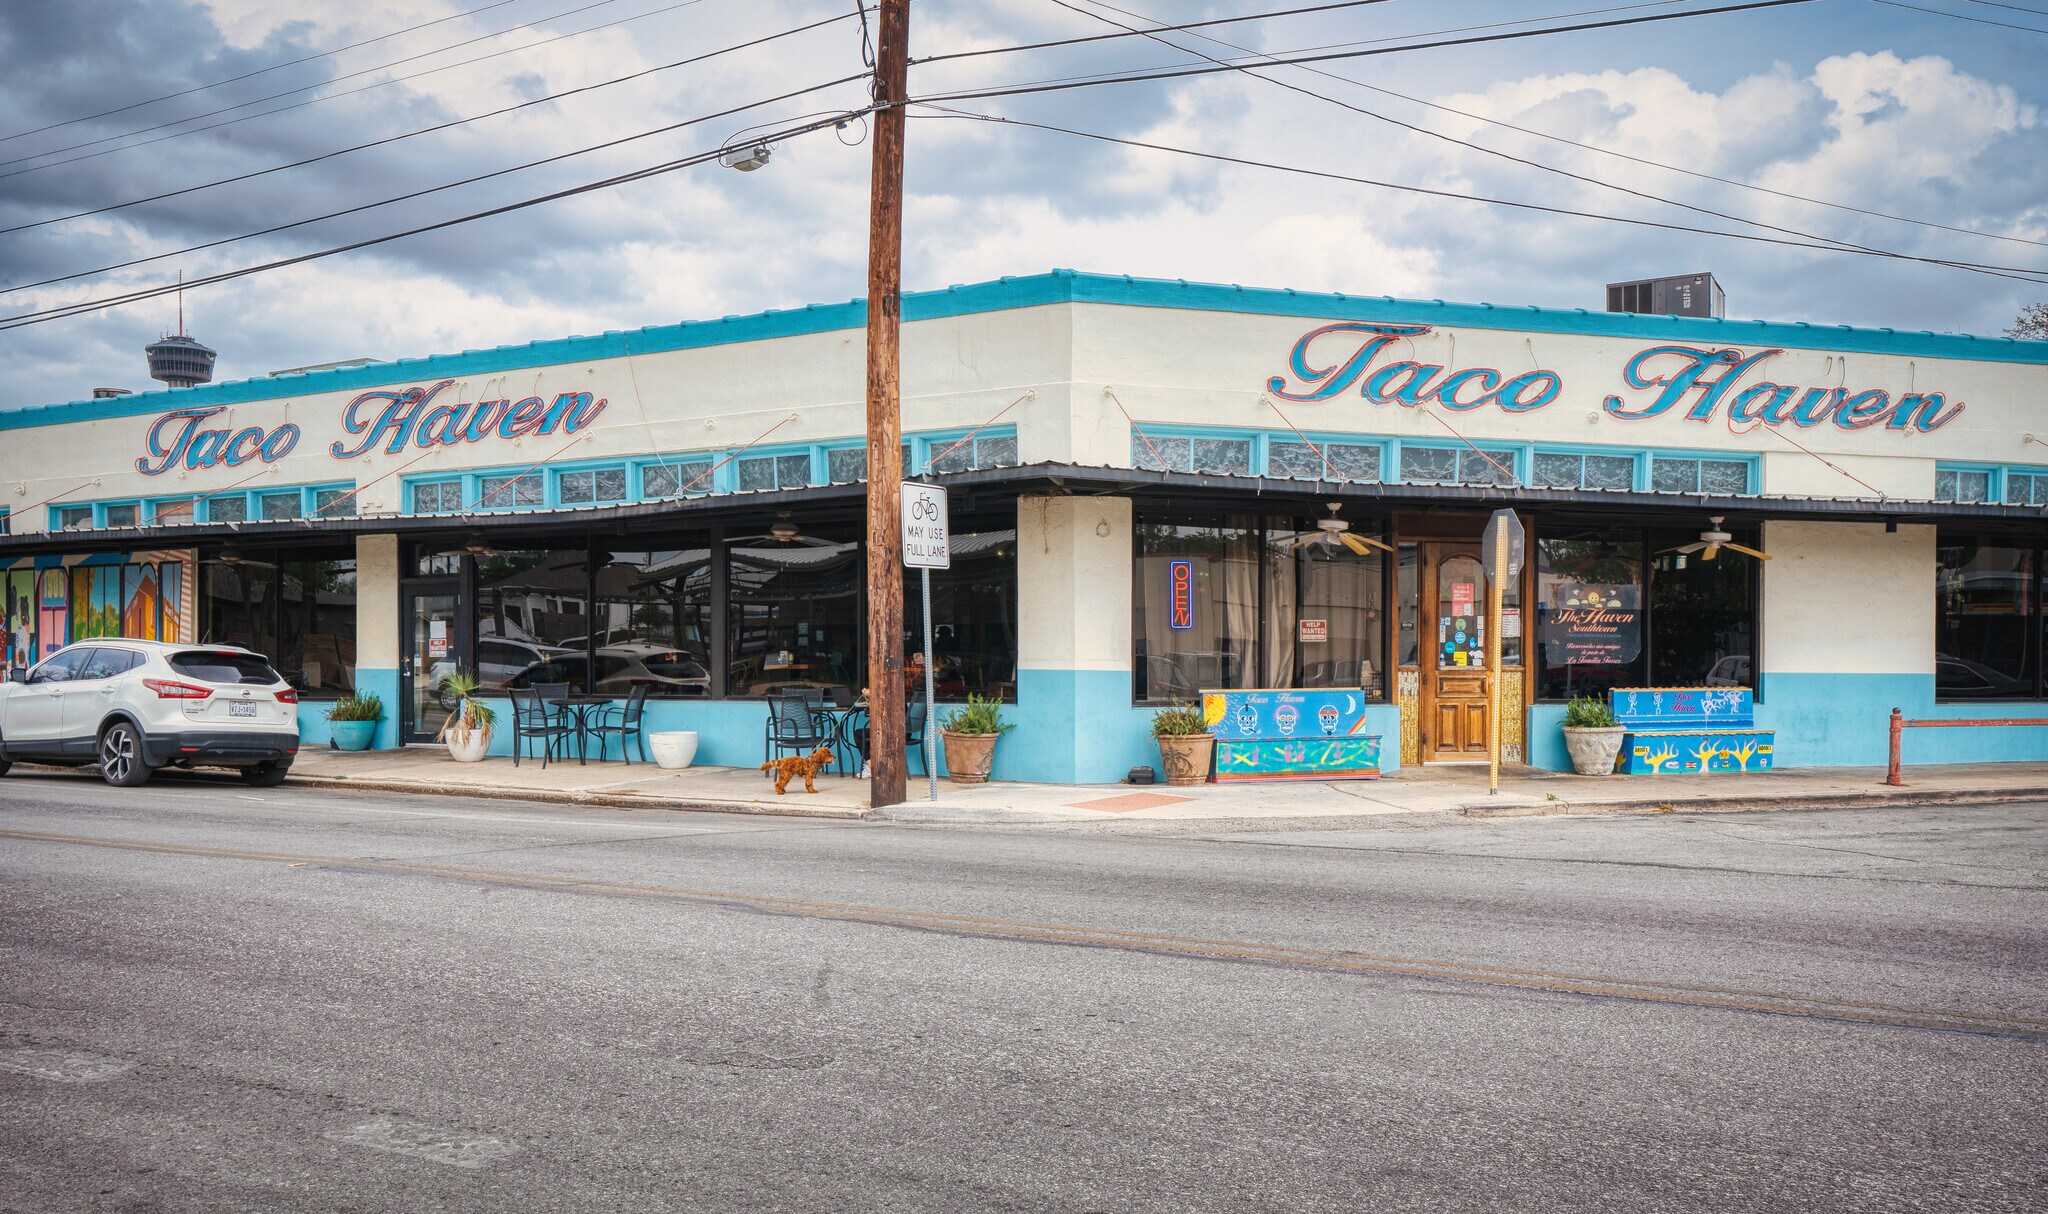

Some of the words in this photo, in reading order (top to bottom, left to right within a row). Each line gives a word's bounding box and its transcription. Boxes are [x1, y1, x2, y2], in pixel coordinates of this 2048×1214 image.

[1267, 322, 1563, 413] Taco
[1602, 345, 1966, 434] Haven
[135, 406, 300, 476] Taco
[329, 379, 607, 459] Haven
[908, 526, 924, 538] MAY
[928, 528, 944, 540] USE
[907, 544, 924, 556] FULL
[928, 545, 946, 558] LANE
[1174, 564, 1190, 626] OPEN
[1551, 608, 1580, 624] The
[1581, 608, 1634, 624] Haven
[1568, 624, 1618, 633] Southtown
[1246, 693, 1269, 704] Taco
[1275, 692, 1306, 703] Haven
[1674, 690, 1693, 700] Taco
[1670, 702, 1696, 712] Haven
